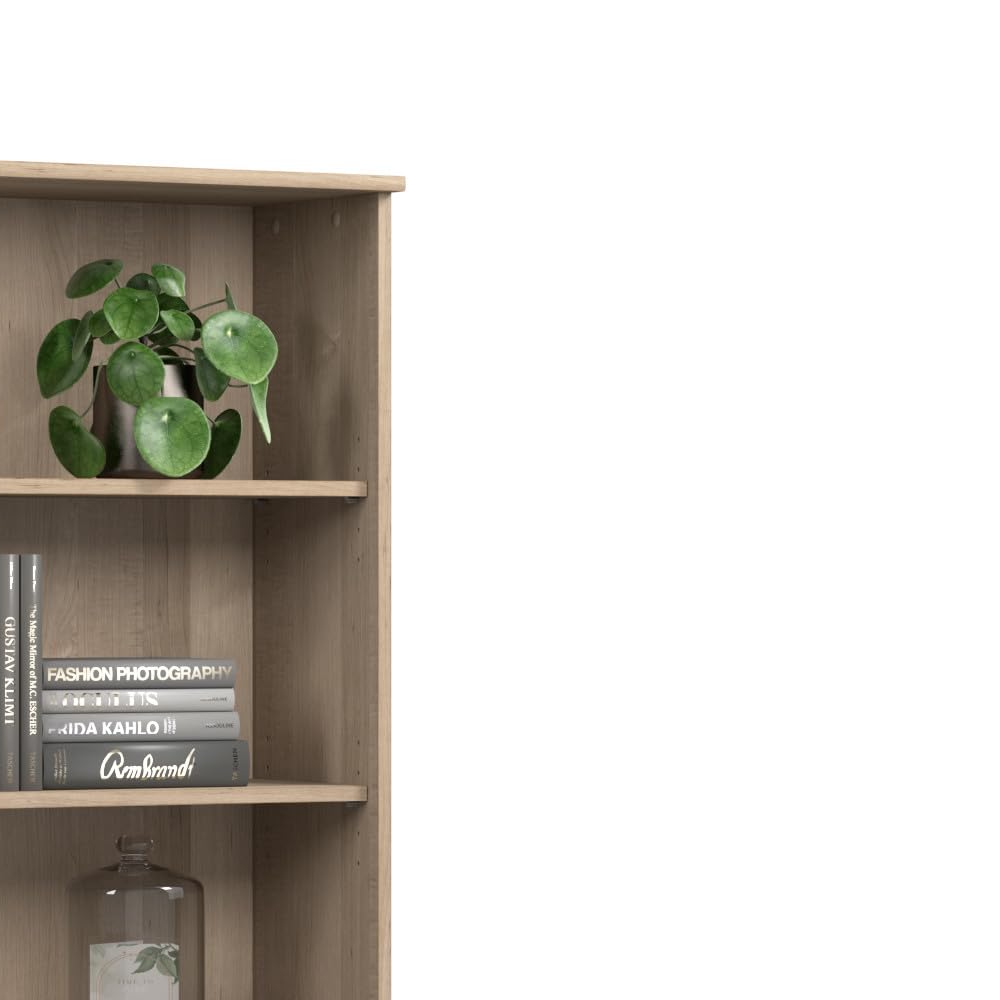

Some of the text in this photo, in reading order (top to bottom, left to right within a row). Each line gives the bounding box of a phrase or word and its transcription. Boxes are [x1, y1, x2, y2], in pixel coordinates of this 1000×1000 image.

[29, 603, 37, 618] The
[28, 620, 37, 643] Magic
[29, 645, 37, 669] Mirror
[4, 616, 16, 726] GUSTAV KLIMT
[29, 670, 37, 679] of
[47, 665, 233, 682] FASHION PHOTOGRAPHY
[29, 700, 37, 735] ESCHER
[101, 720, 160, 735] KAHLO
